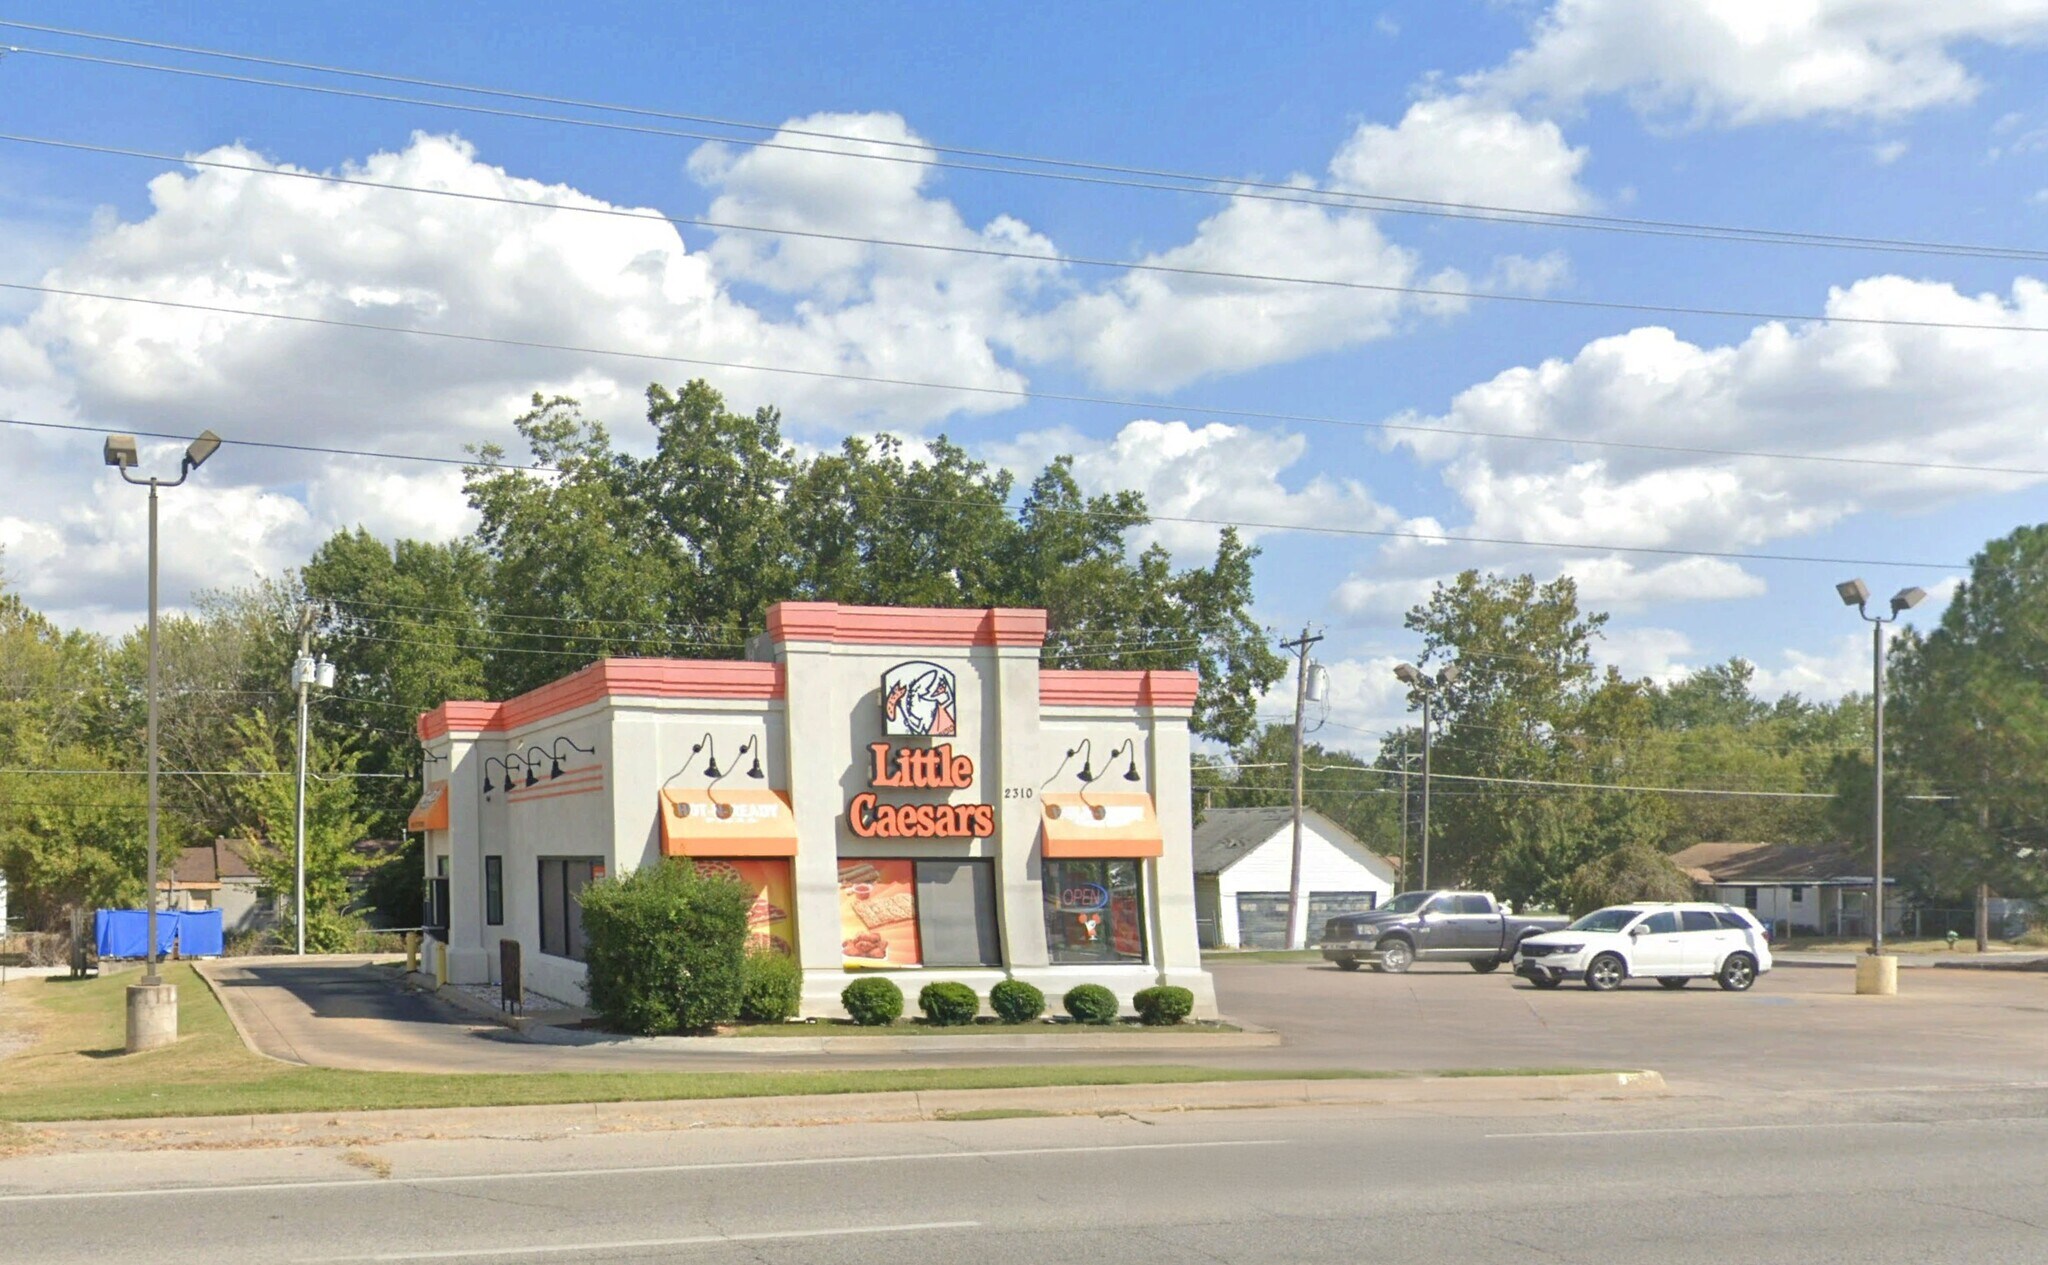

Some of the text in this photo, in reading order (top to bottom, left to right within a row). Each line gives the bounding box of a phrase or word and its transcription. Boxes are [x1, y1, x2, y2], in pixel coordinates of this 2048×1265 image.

[869, 742, 974, 789] Little
[1004, 787, 1033, 799] 2310
[849, 792, 995, 838] Caesars
[1063, 888, 1101, 906] OPEN
